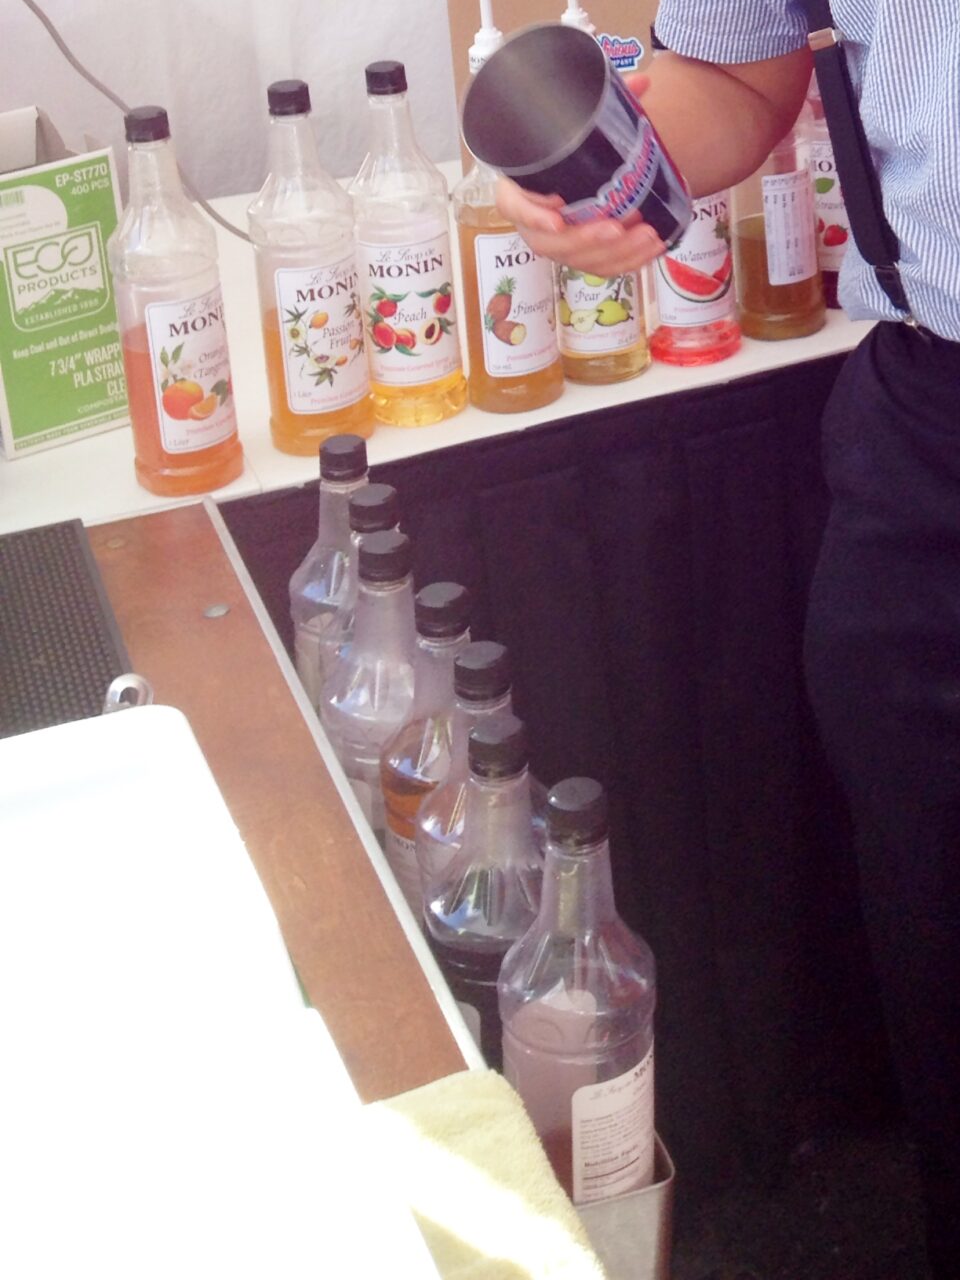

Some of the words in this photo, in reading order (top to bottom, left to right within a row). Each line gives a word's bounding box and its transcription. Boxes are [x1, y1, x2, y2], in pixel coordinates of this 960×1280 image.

[55, 163, 108, 188] EP-ST770
[91, 177, 110, 192] PCS
[12, 231, 95, 280] ECO
[368, 253, 444, 279] MONIN
[17, 265, 98, 296] PRODUCTS
[575, 288, 601, 305] Pear
[393, 306, 428, 326] Peach
[49, 361, 56, 377] 7
[84, 342, 121, 367] WRAPP
[74, 369, 94, 388] PLA
[107, 377, 128, 397] CLE
